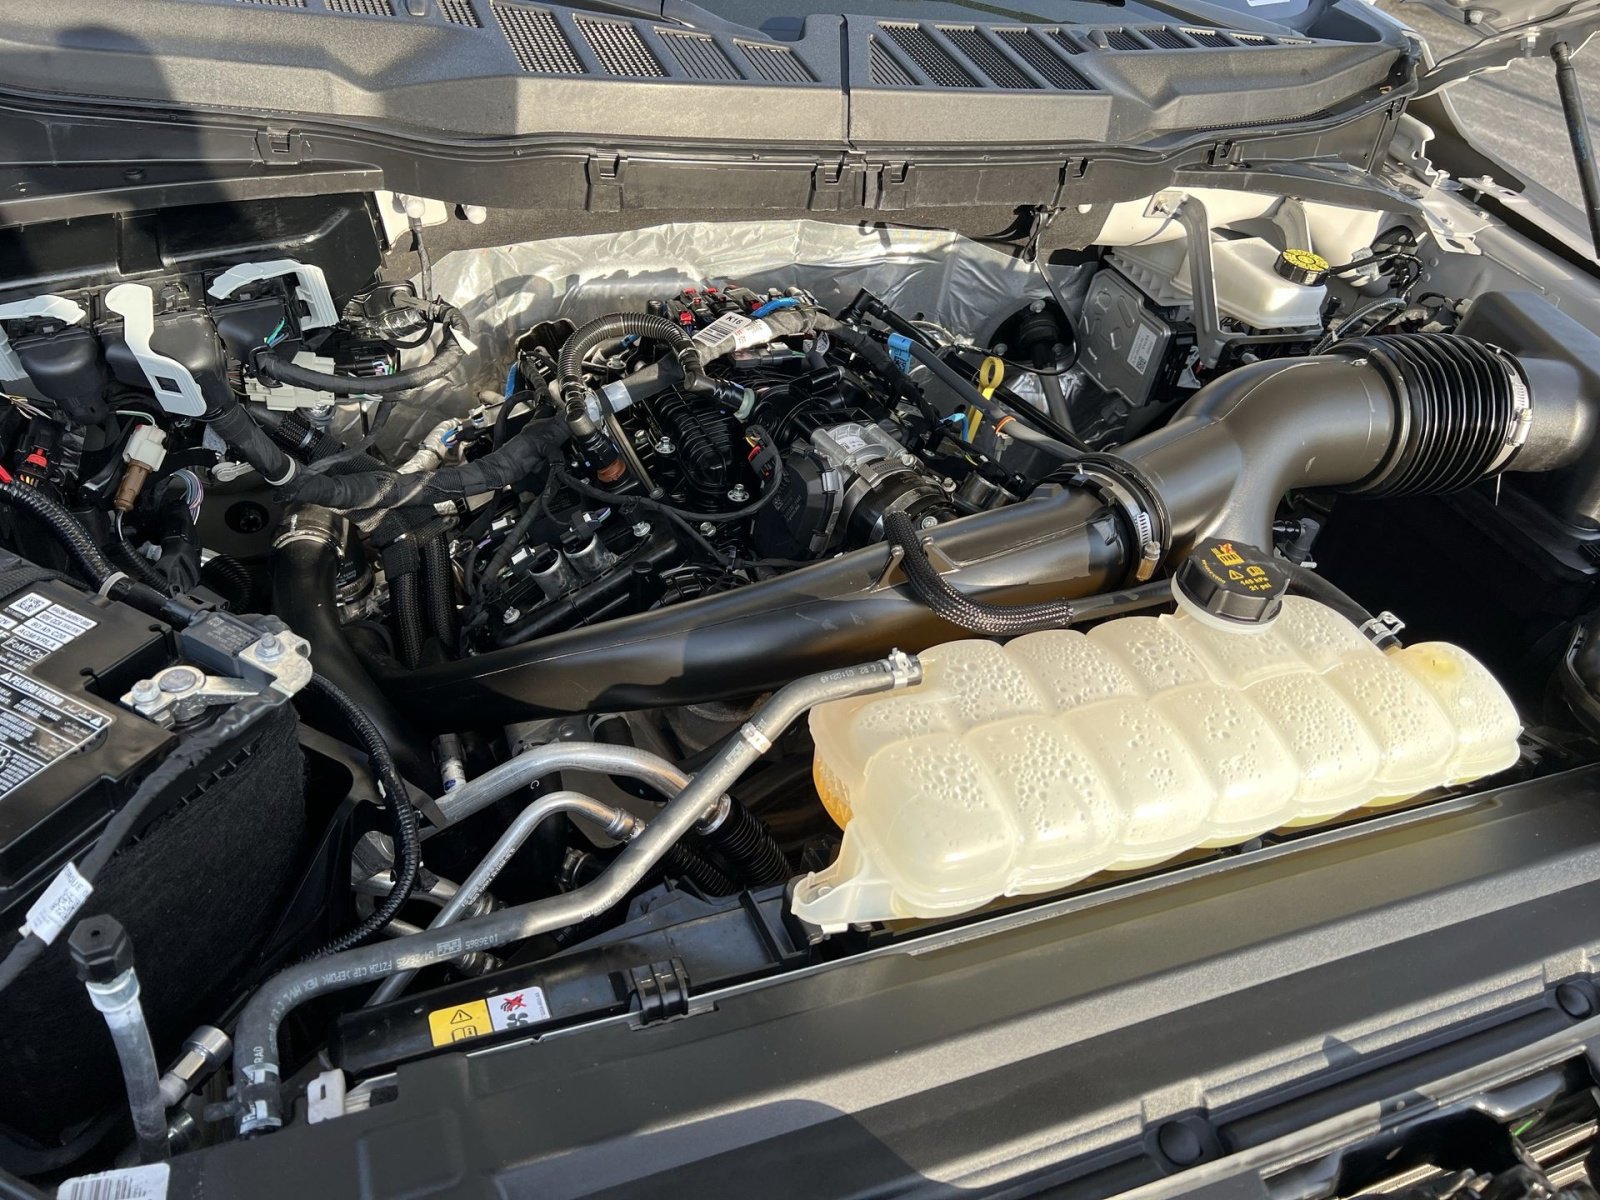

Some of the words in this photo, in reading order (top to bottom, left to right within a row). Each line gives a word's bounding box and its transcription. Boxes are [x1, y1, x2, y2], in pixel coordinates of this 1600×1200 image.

[726, 315, 743, 325] K16
[6, 638, 44, 659] FoMoCo
[252, 1046, 264, 1064] RAD
